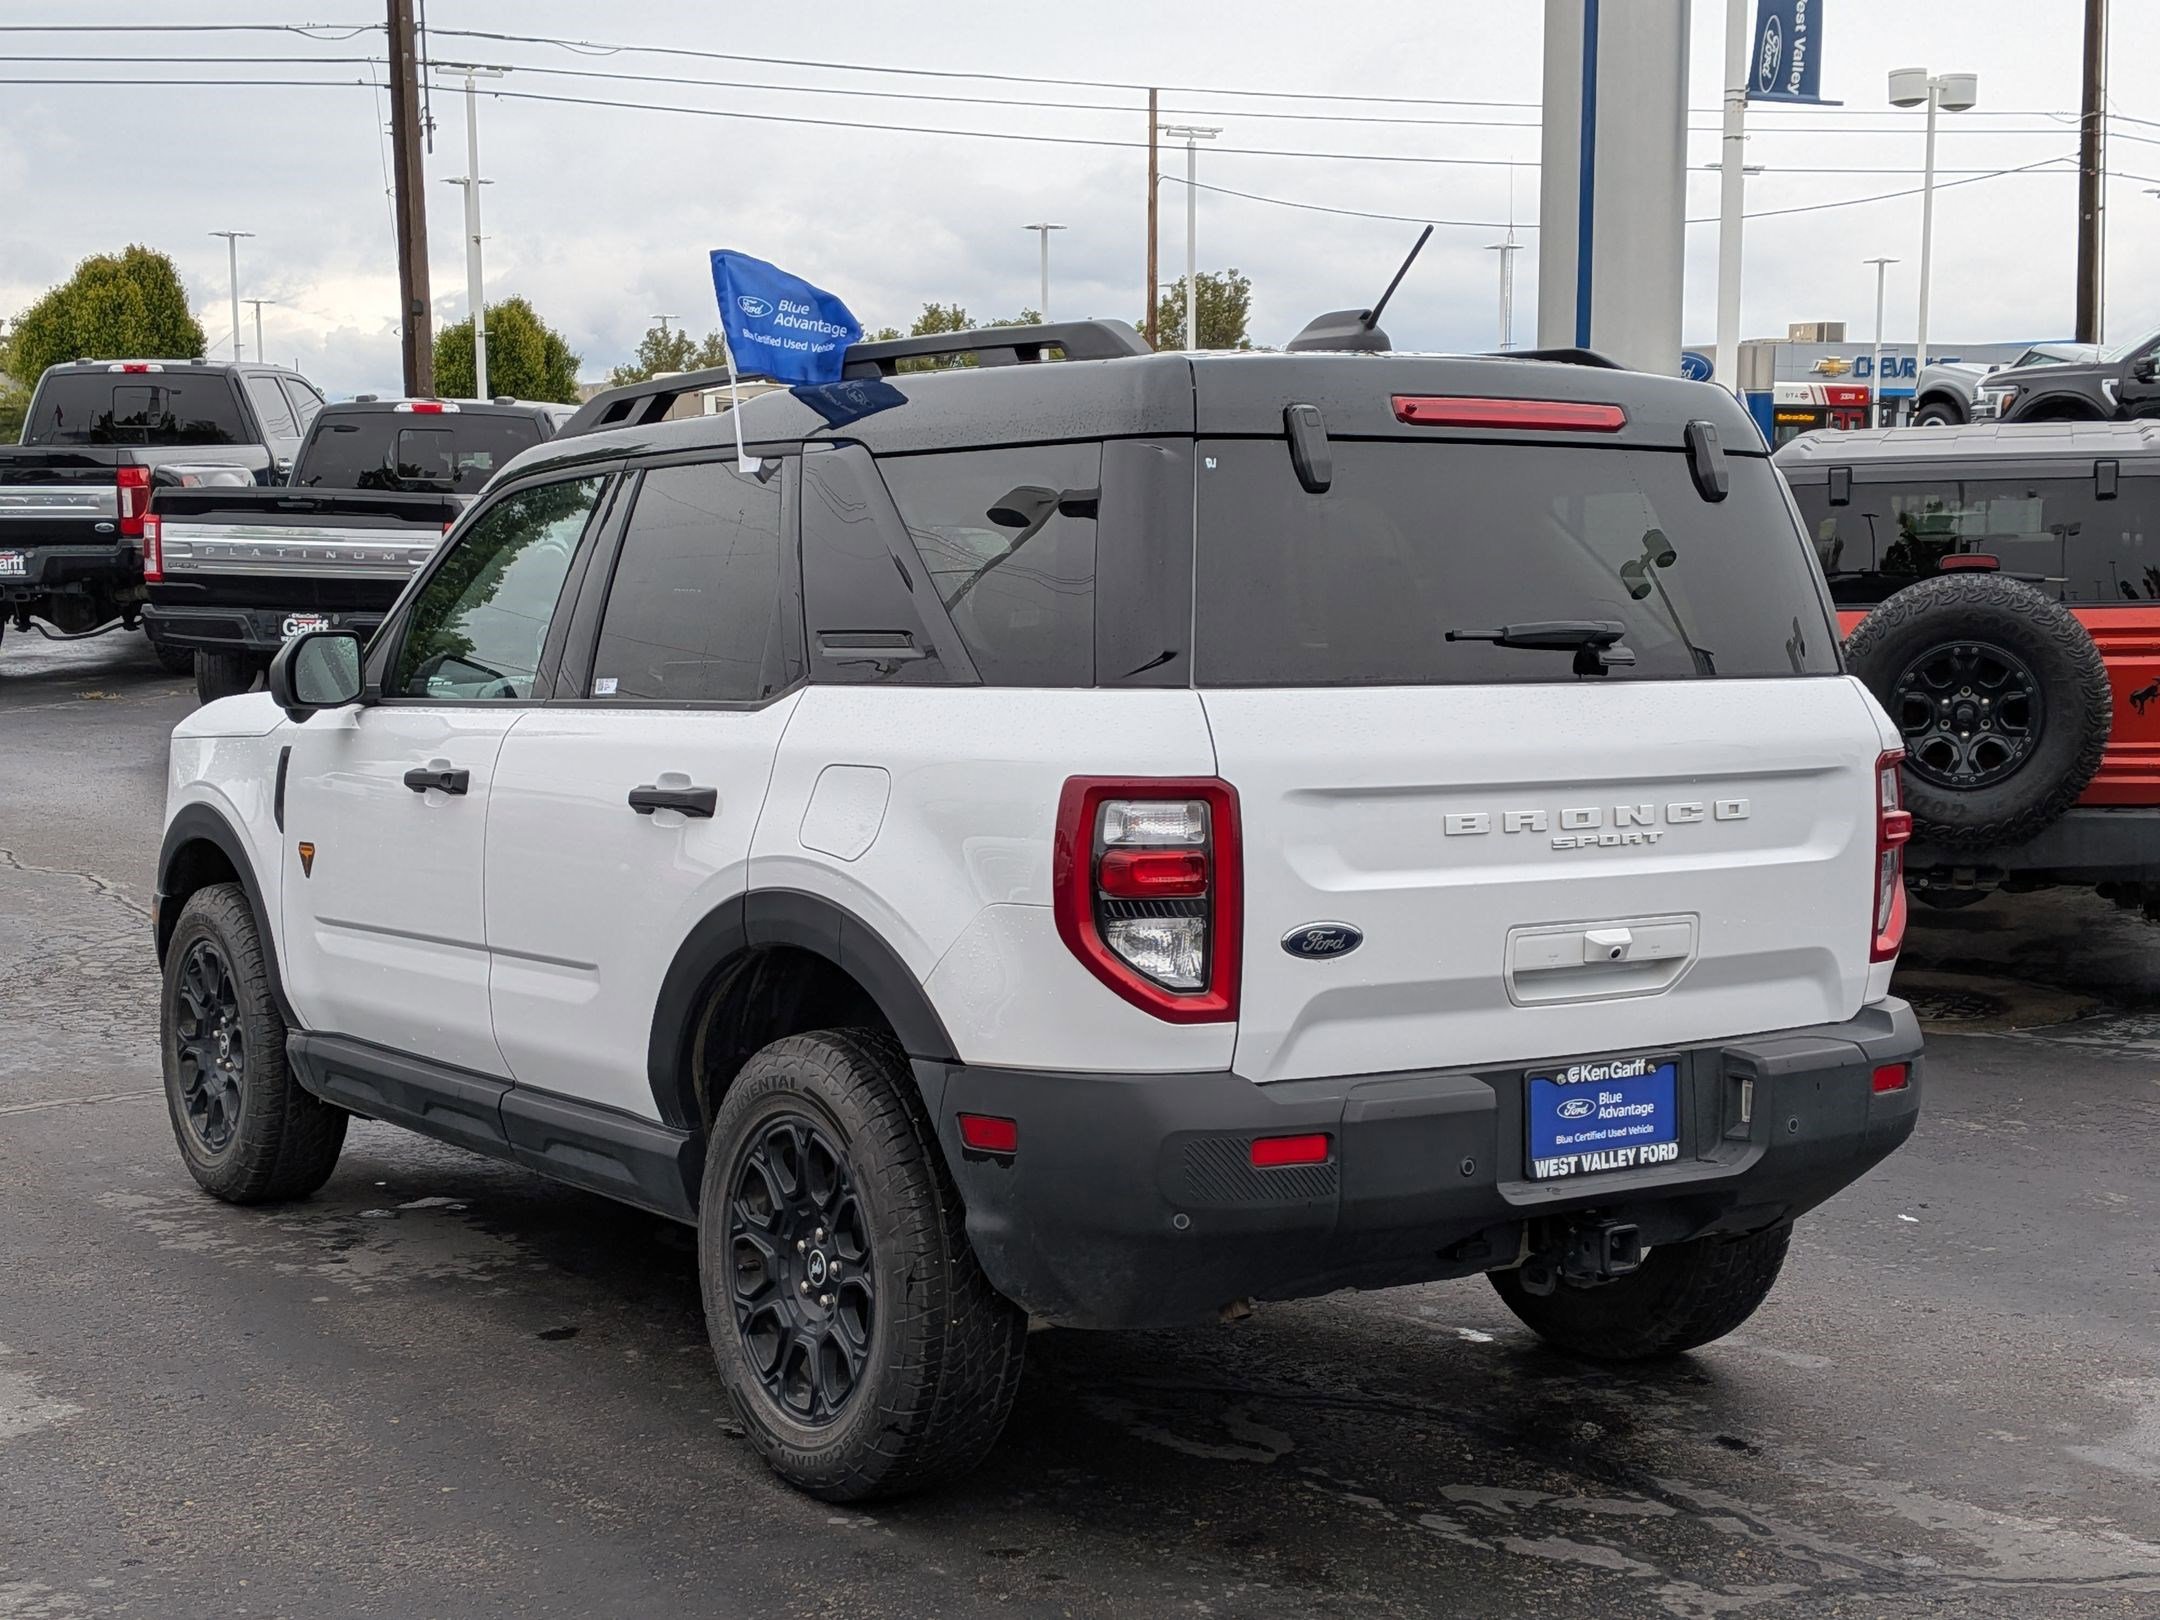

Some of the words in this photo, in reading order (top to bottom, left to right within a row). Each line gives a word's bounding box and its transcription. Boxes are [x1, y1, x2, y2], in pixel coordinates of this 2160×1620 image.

[1795, 0, 1808, 32] est
[1762, 29, 1779, 79] Ford
[1787, 36, 1807, 96] Valley
[778, 299, 810, 315] Blue
[773, 312, 848, 338] Advantage
[754, 331, 782, 347] Certified
[783, 338, 808, 351] Used
[1854, 356, 1961, 378] CHEVR
[0, 555, 24, 570] arff
[205, 547, 396, 561] PLATINUM
[283, 618, 330, 636] Garff
[1444, 799, 1750, 836] BRONCO
[1551, 831, 1664, 849] SPORT
[1302, 930, 1346, 951] Ford
[1580, 1065, 1610, 1083] Ken
[1610, 1058, 1646, 1079] Garff
[1599, 1092, 1623, 1104] Blue
[1598, 1103, 1654, 1120] Advantage
[1556, 1135, 1573, 1145] Blue
[1574, 1130, 1606, 1142] Certified
[1608, 1129, 1627, 1138] Used
[1629, 1124, 1654, 1135] Vehicle
[1534, 1156, 1578, 1179] WEST
[1581, 1147, 1637, 1172] VALLEY
[1640, 1142, 1679, 1165] FORD
